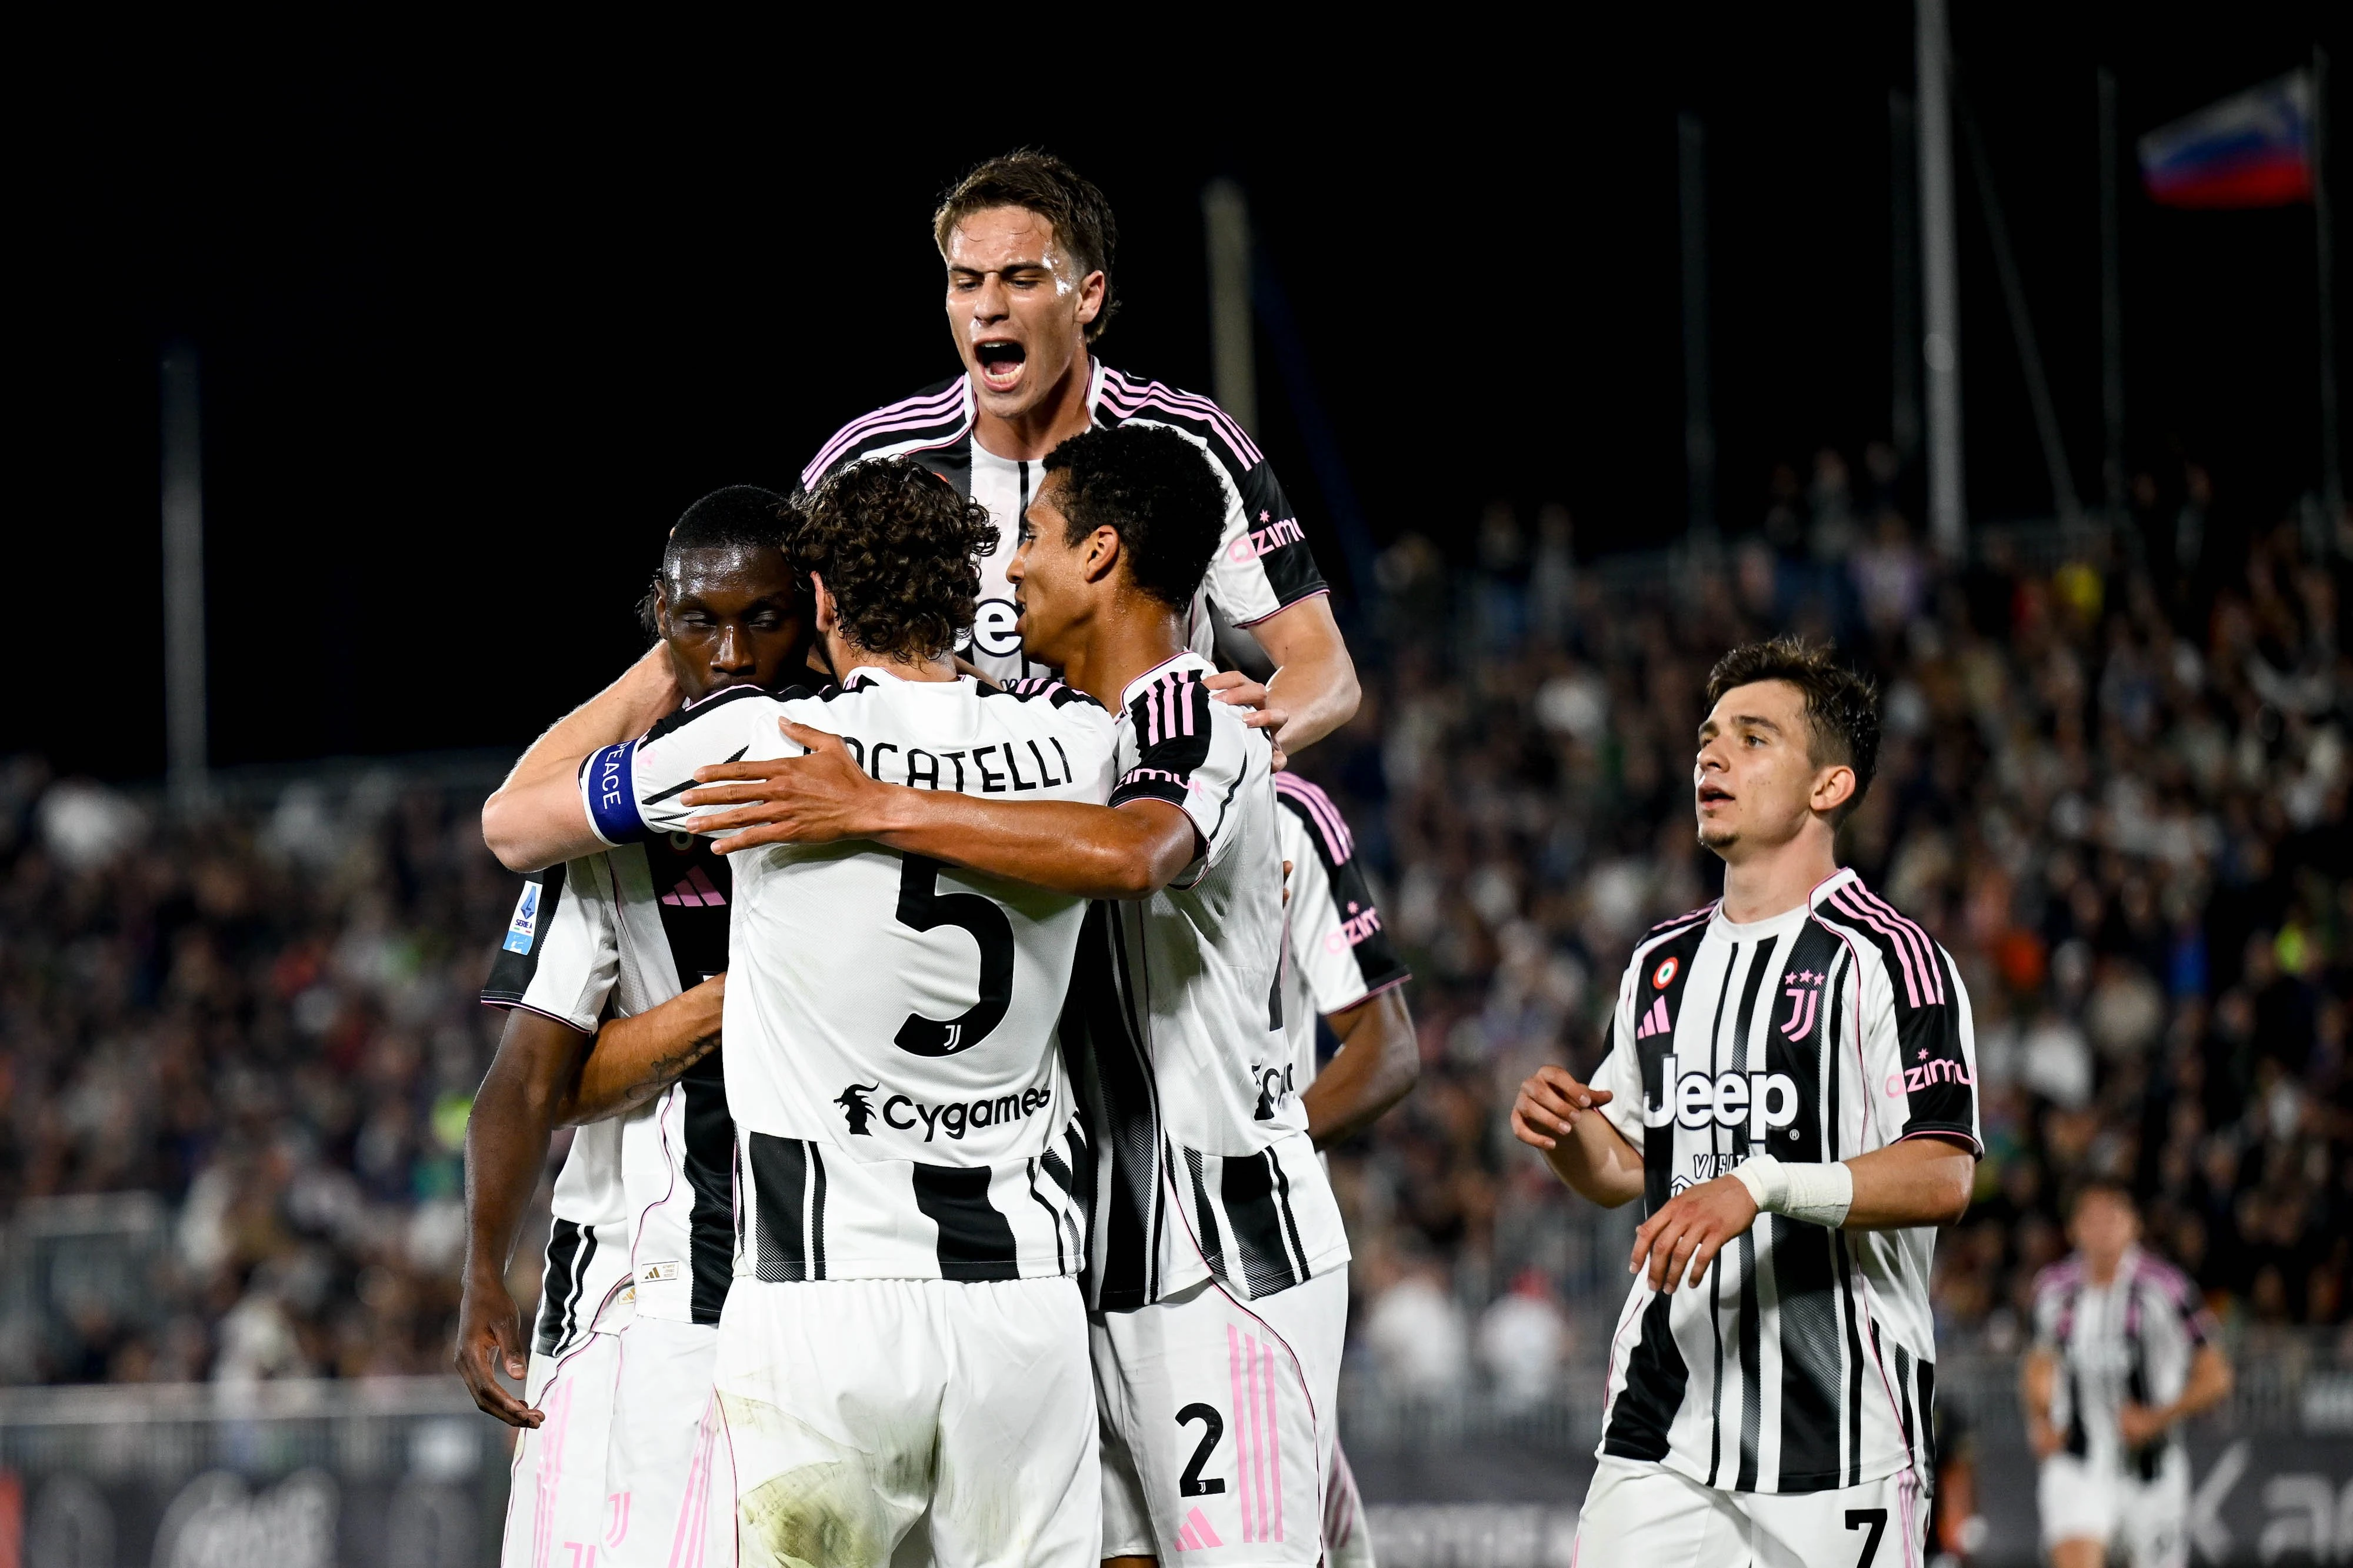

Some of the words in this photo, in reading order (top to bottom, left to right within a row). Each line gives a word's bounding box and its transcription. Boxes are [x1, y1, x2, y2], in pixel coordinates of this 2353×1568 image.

[602, 741, 632, 809] PEACE
[804, 736, 1073, 792] CATELLI
[515, 919, 529, 929] SERIE
[894, 848, 1015, 1057] 5
[883, 1084, 1051, 1142] Cygames
[1643, 1054, 1799, 1143] Jeep
[1175, 1403, 1225, 1497] 2
[1845, 1509, 1887, 1568] 7
